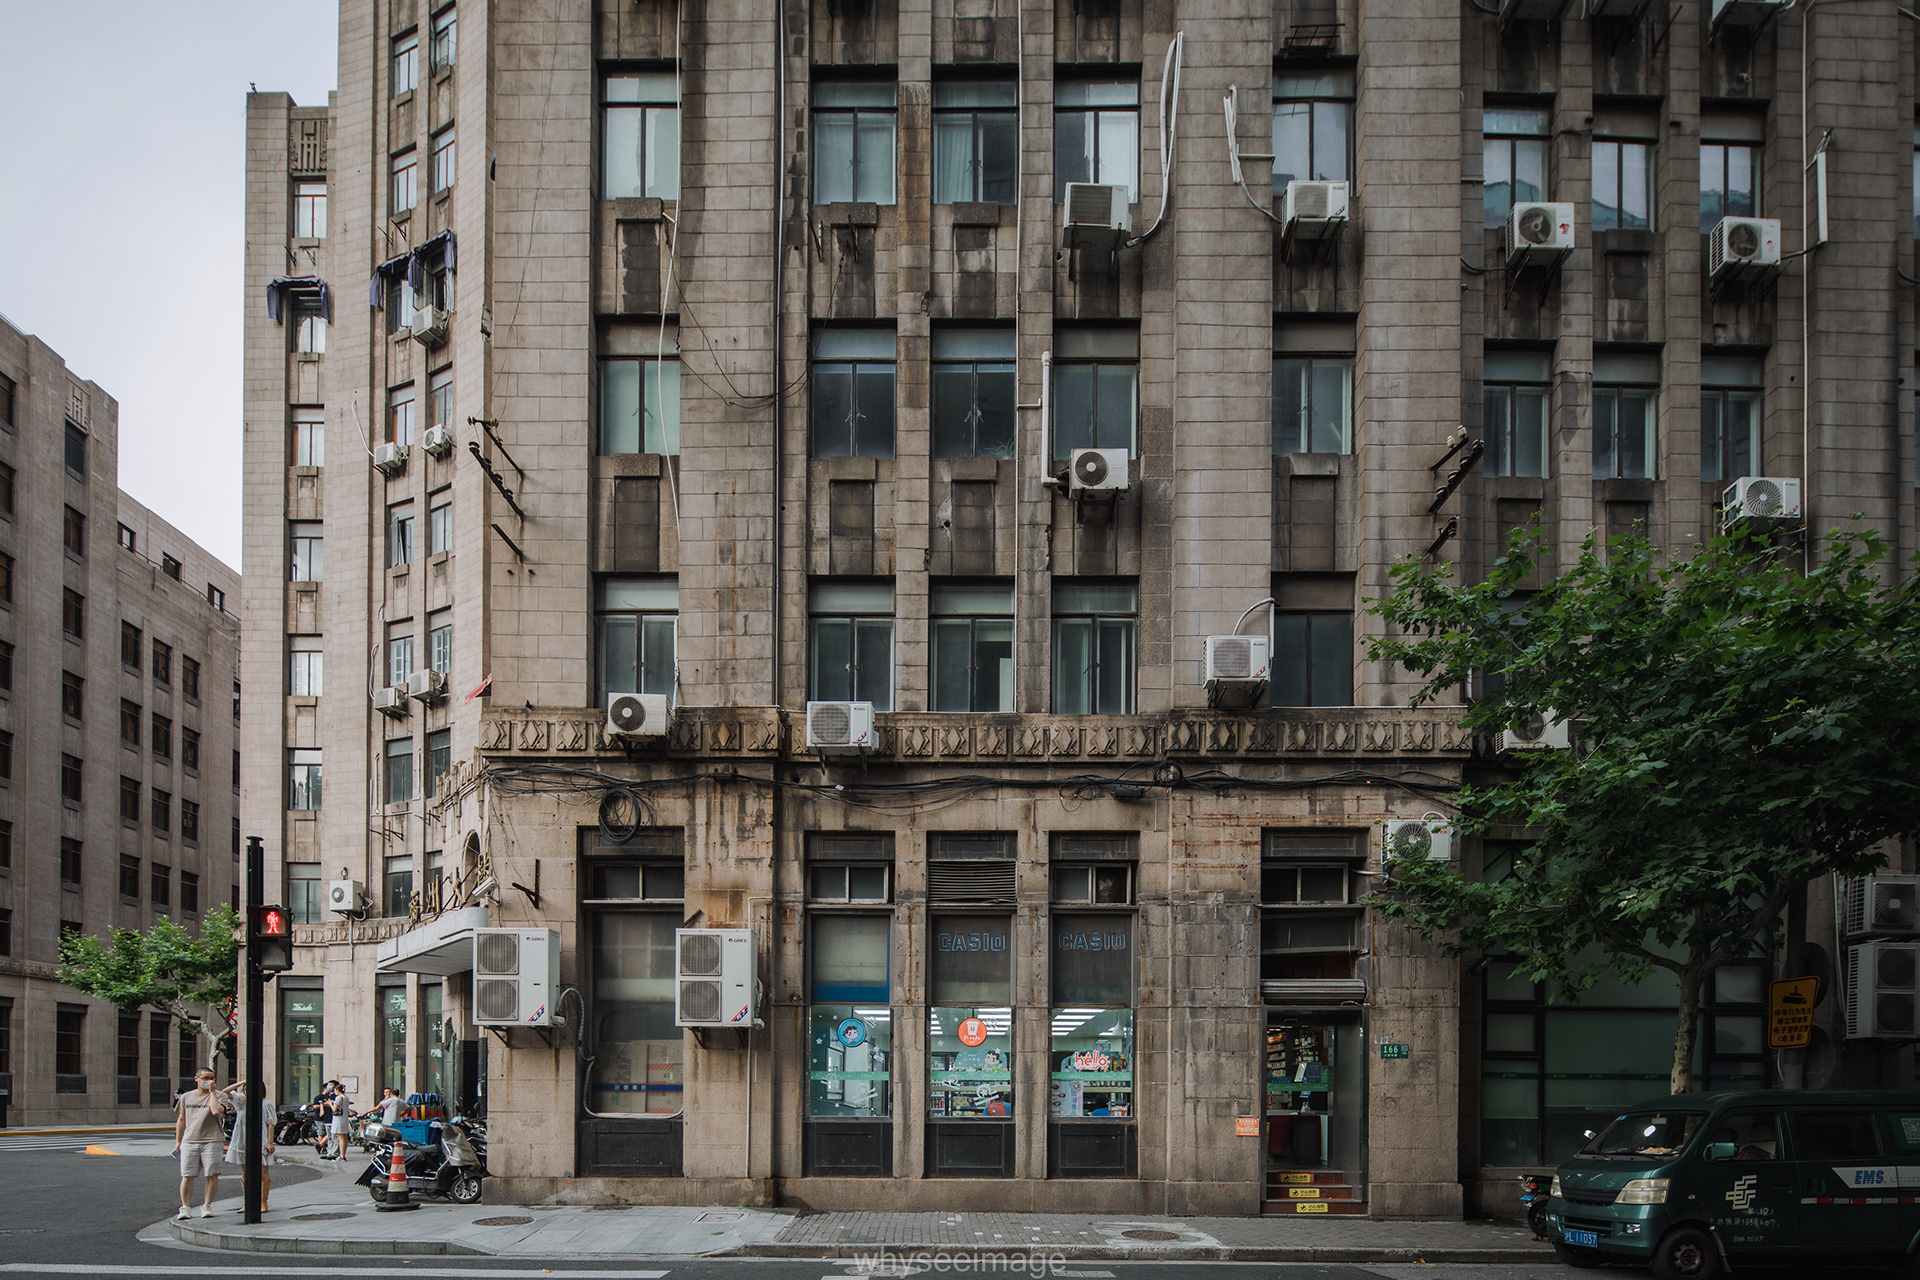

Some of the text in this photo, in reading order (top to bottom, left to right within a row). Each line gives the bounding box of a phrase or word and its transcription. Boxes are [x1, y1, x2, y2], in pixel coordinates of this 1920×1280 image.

[937, 932, 1006, 952] CASIO
[1058, 932, 1126, 951] CASIO
[1383, 1045, 1399, 1054] 166
[1075, 1051, 1109, 1067] hello
[1854, 1170, 1885, 1185] EMS
